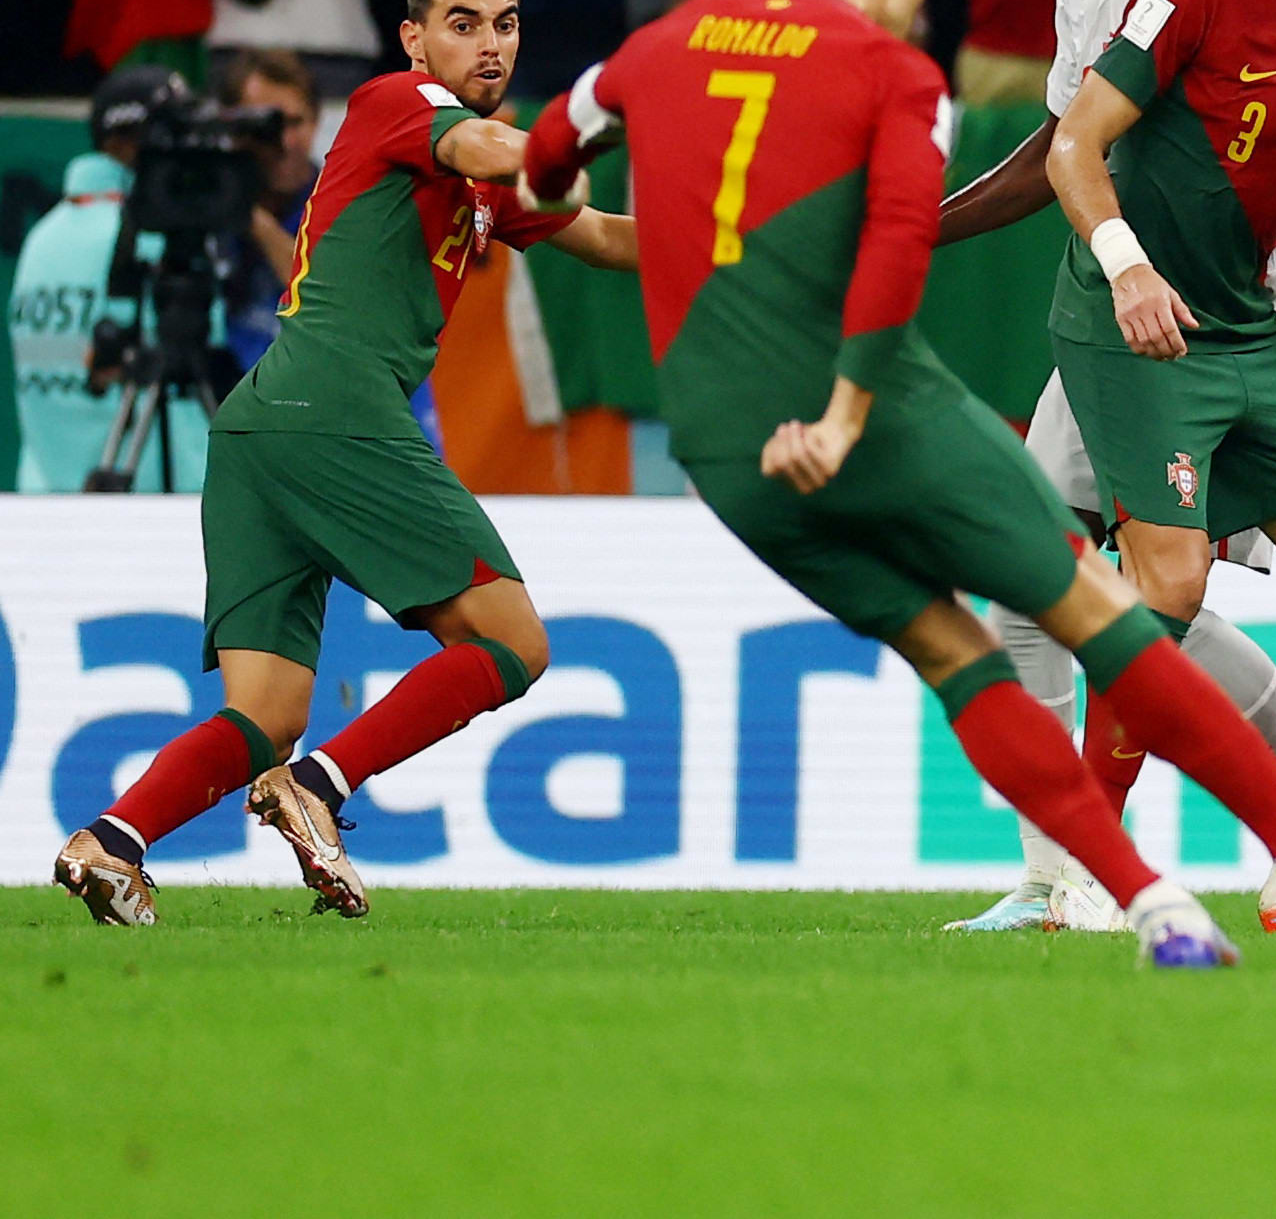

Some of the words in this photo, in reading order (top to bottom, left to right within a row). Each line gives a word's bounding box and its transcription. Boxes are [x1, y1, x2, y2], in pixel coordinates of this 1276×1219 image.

[688, 13, 819, 58] RONALDO
[1226, 100, 1268, 164] 3
[706, 69, 777, 266] 7
